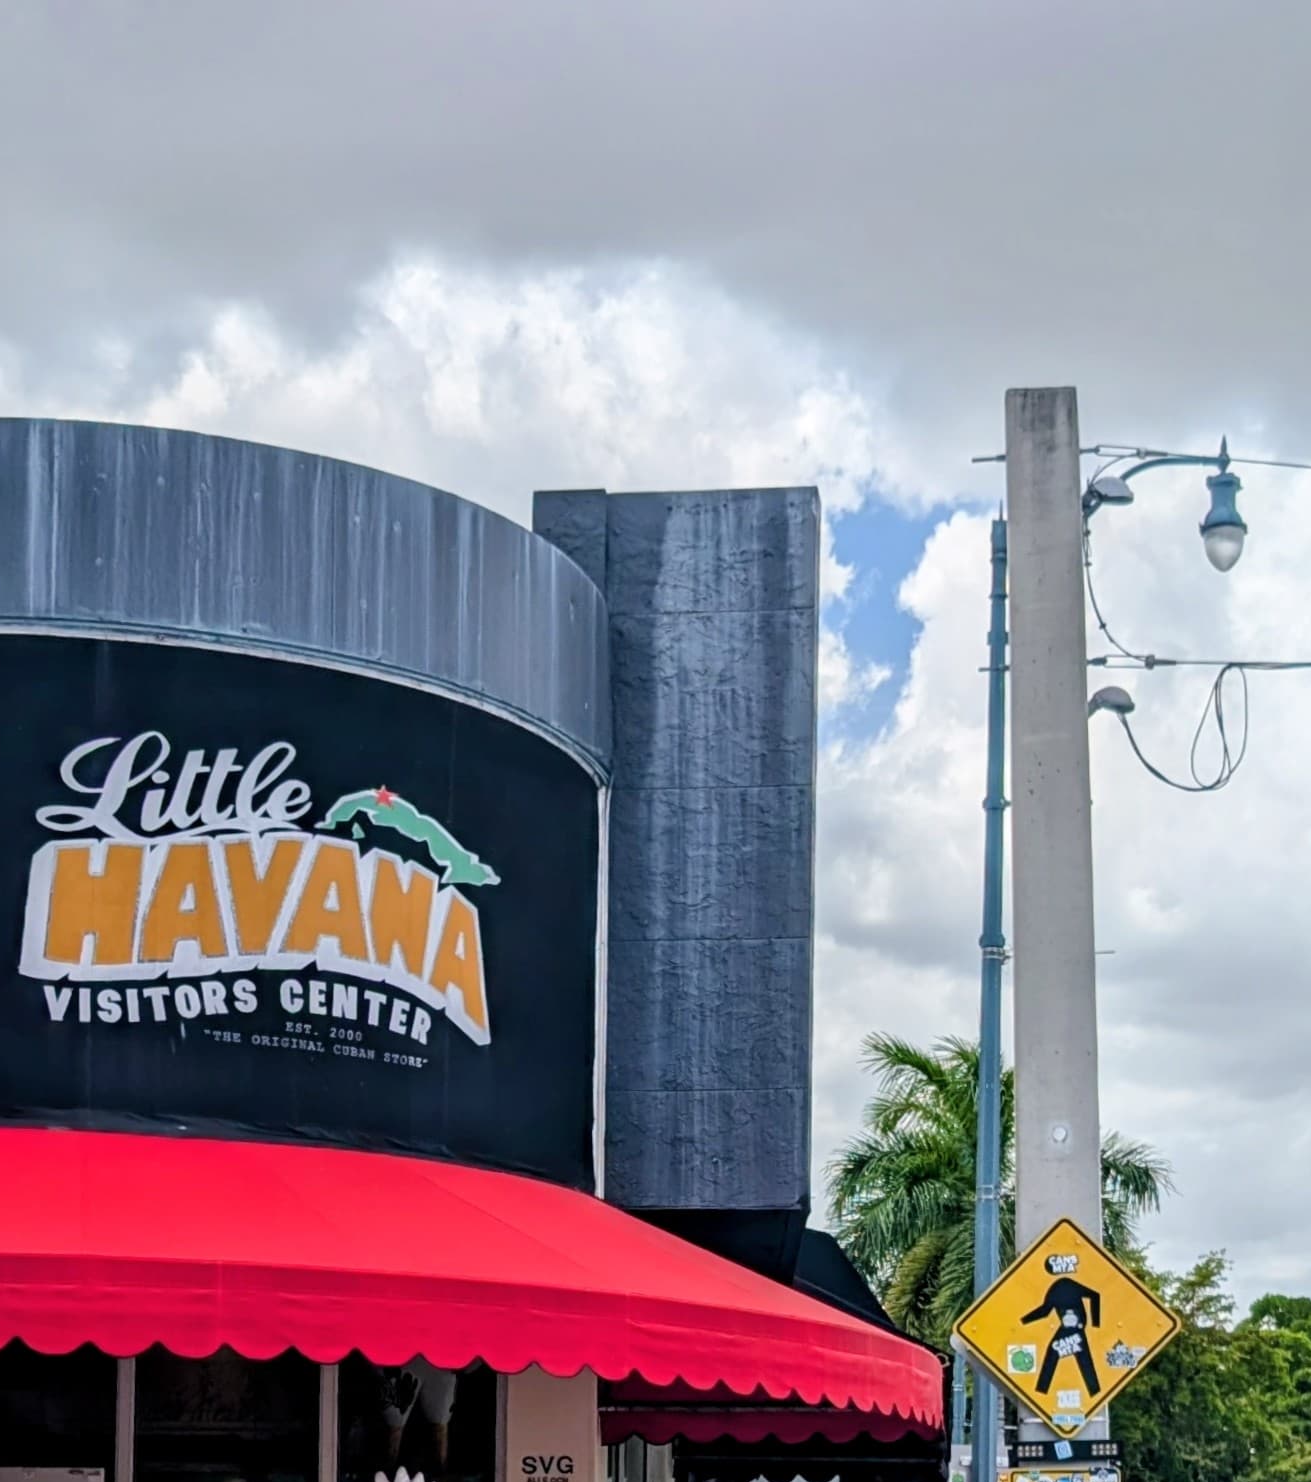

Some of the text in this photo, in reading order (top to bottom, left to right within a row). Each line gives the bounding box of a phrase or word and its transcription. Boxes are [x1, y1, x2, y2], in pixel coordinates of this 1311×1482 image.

[35, 730, 313, 838] Little
[21, 833, 491, 1046] HAVANA
[43, 979, 432, 1046] VISITORS CENTER
[285, 1021, 363, 1042] EST. 2000
[251, 1034, 325, 1052] ORIGINAL
[333, 1044, 375, 1060] CUBAN
[521, 1455, 574, 1475] SVG
